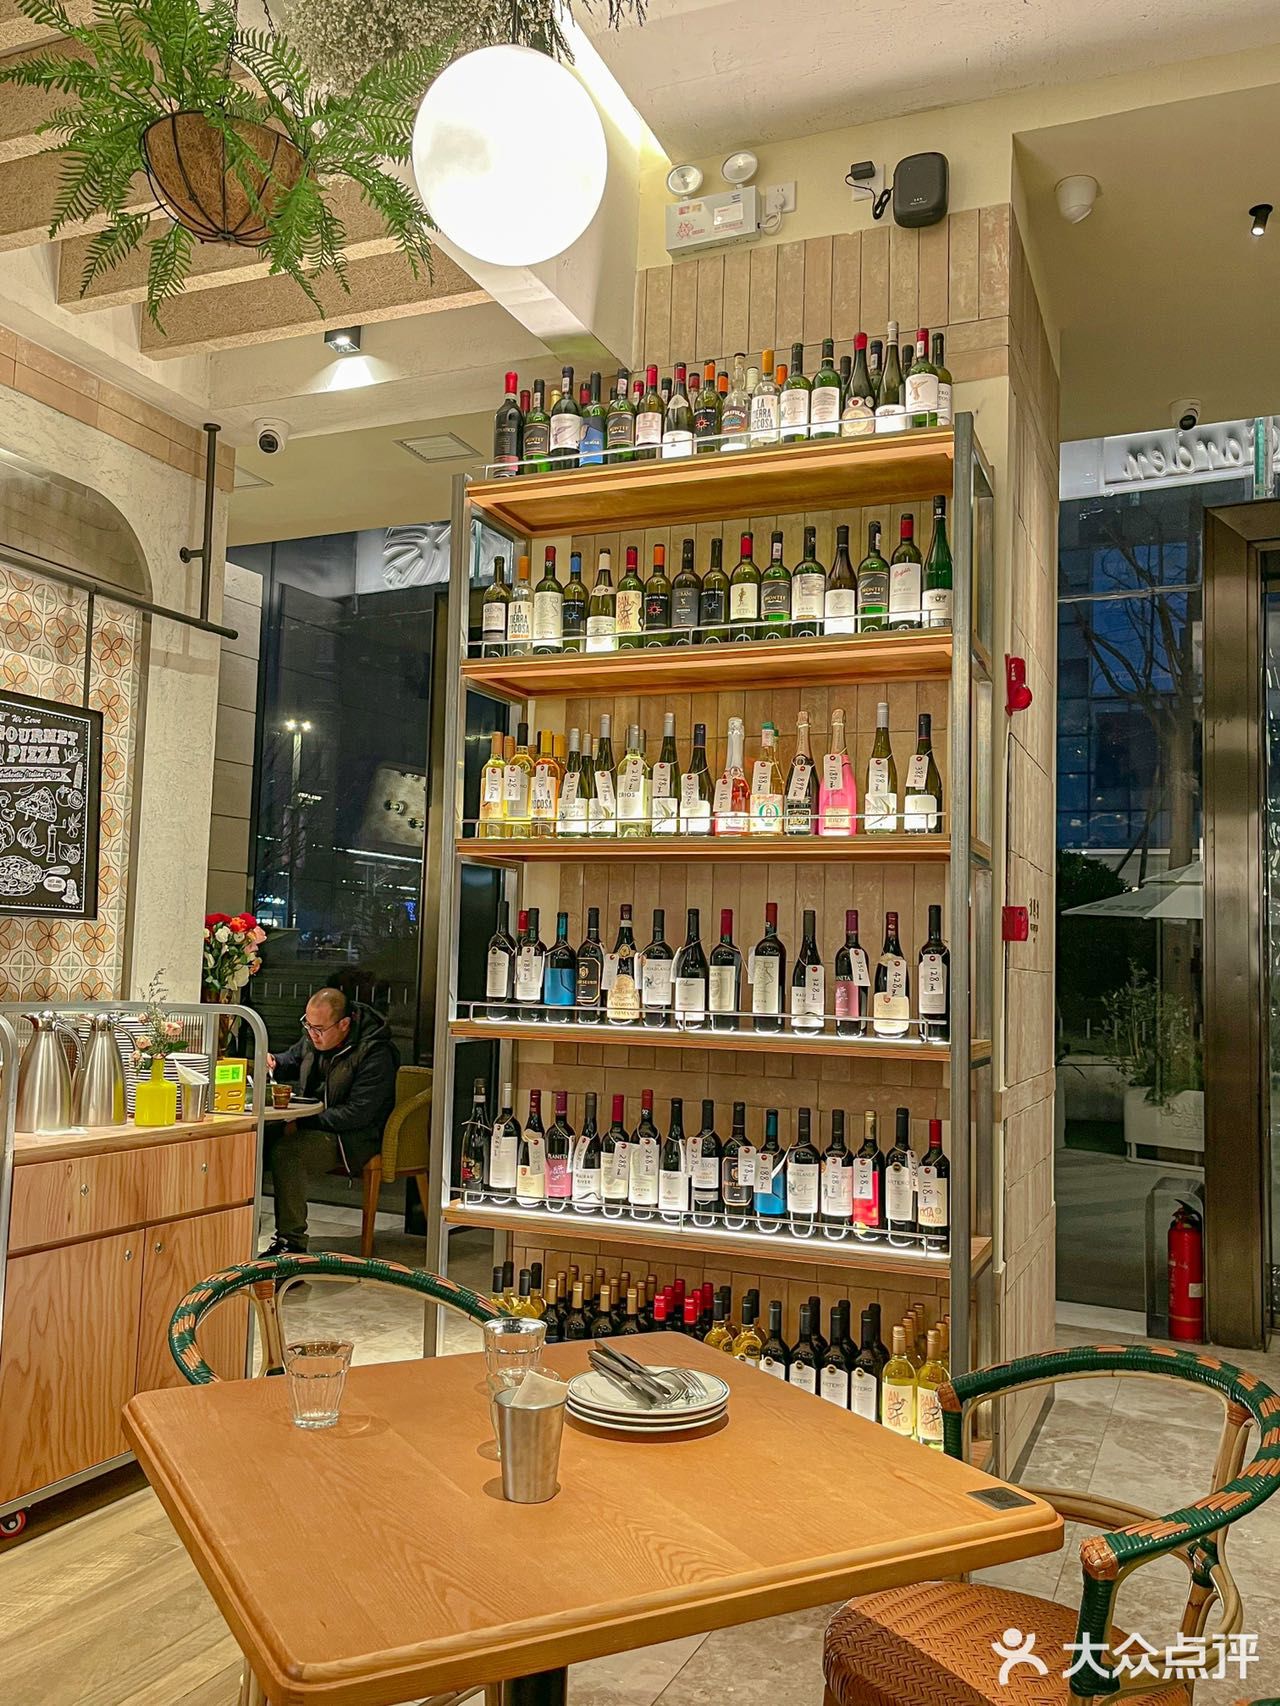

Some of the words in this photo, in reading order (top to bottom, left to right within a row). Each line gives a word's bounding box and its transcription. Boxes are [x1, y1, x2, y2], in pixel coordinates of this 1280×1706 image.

[757, 398, 765, 408] LA
[514, 604, 522, 613] LA
[11, 714, 22, 724] We
[23, 715, 41, 724] Serve
[6, 744, 60, 764] PIZZA
[508, 776, 518, 788] 128
[894, 973, 905, 988] 428
[930, 968, 941, 982] 128
[760, 1167, 768, 1180] 188
[860, 1170, 869, 1184] 138
